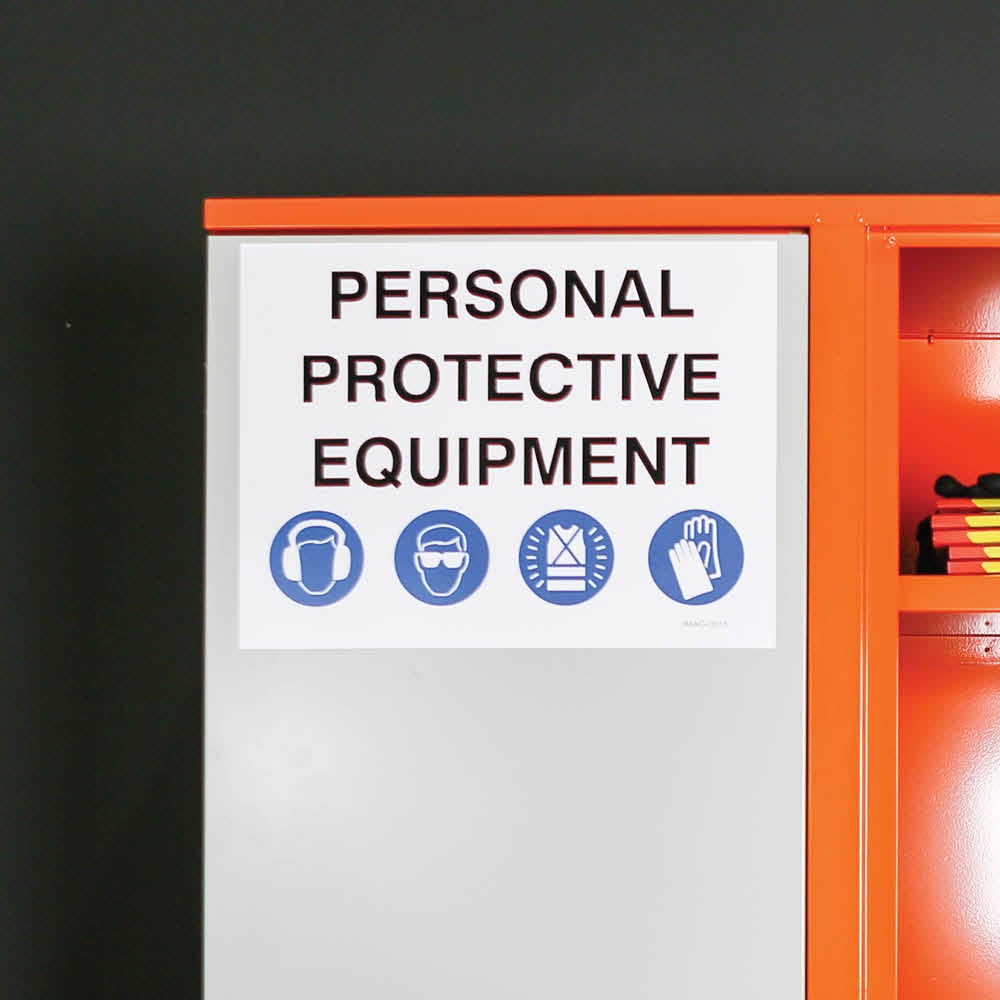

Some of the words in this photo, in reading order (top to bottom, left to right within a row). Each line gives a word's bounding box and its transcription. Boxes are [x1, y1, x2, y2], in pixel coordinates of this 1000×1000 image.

[330, 268, 695, 320] PERSONAL
[302, 352, 722, 403] PROTECTIVE
[313, 436, 711, 489] EQUIPMENT
